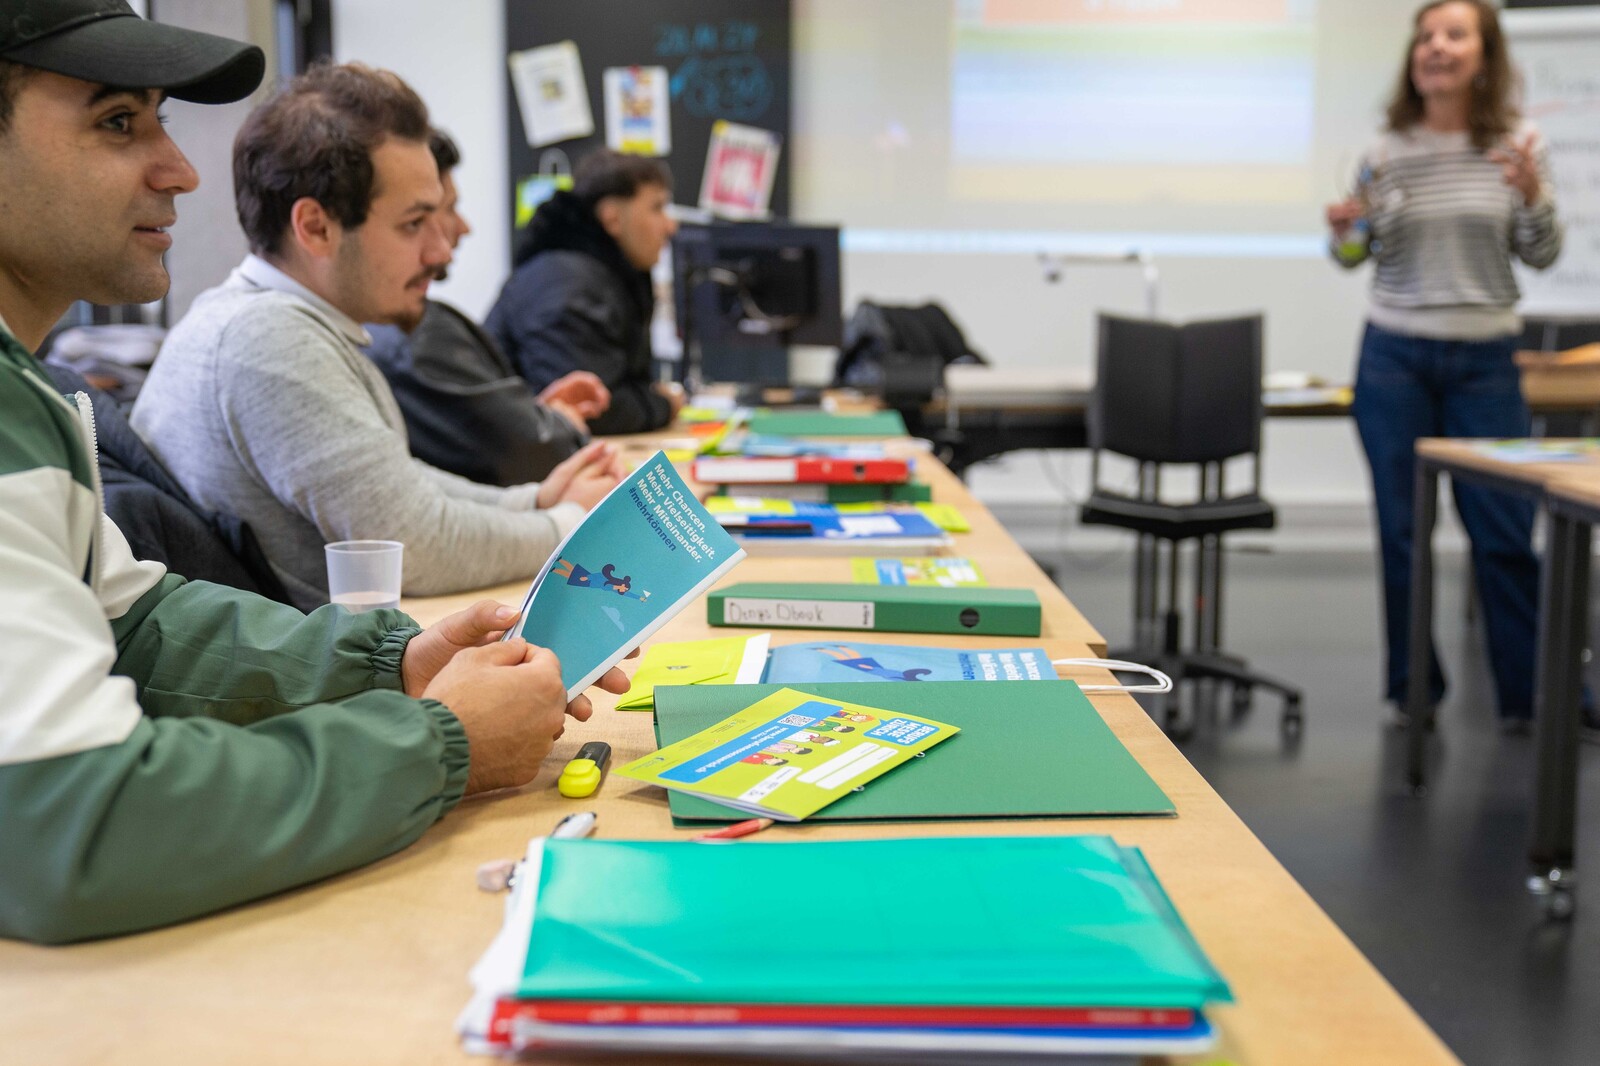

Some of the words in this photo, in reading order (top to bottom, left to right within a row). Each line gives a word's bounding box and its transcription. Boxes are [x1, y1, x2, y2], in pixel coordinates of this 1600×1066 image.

[628, 487, 677, 551] #mehrkönnen
[637, 479, 656, 505] Mehr
[653, 504, 703, 563] Miteinander.
[646, 471, 665, 497] Mehr
[663, 497, 715, 560] Vielseitigkeit.
[654, 463, 674, 490] Mehr
[672, 490, 706, 533] Chancen.
